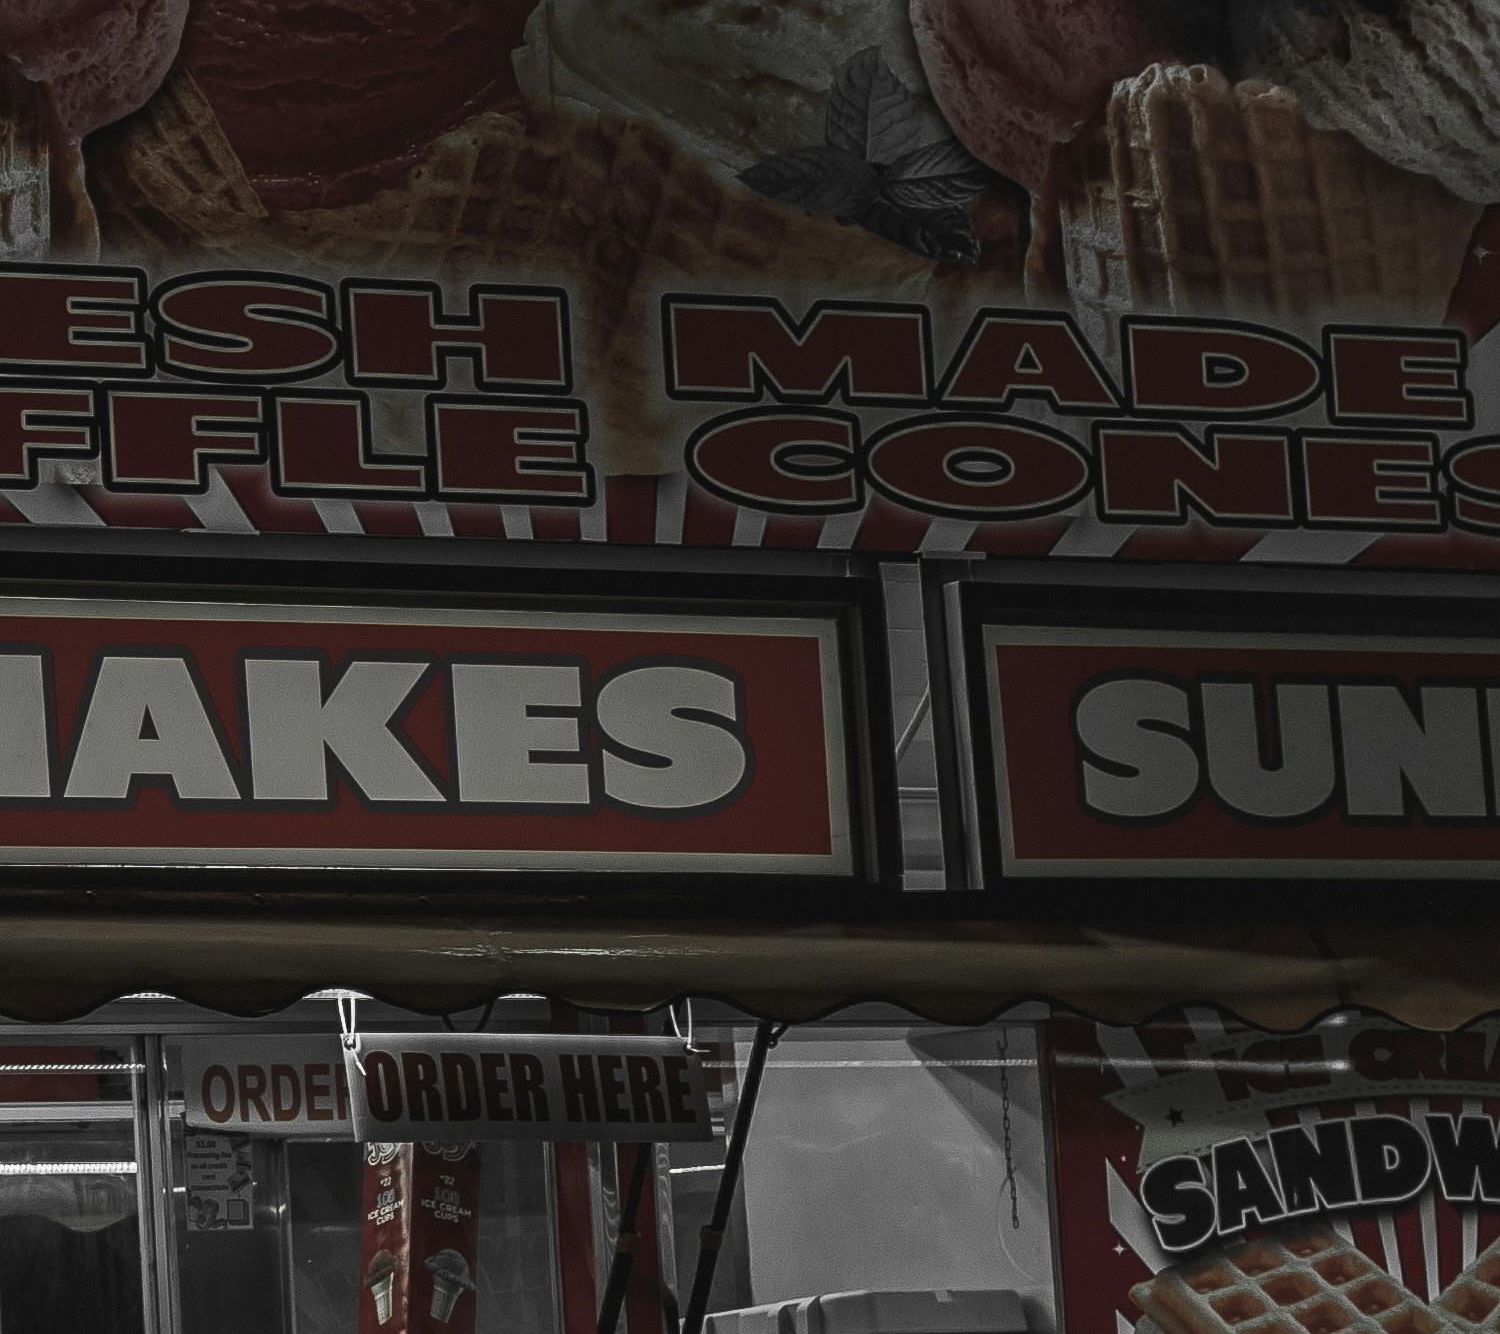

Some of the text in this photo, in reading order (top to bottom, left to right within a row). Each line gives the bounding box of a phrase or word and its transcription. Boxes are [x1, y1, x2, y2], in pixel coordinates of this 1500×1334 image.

[666, 294, 1475, 430] MADE
[364, 1050, 697, 1125] ORDER HERE
[1210, 1033, 1332, 1100] ICE
[421, 1199, 472, 1218] ICE CREAM
[434, 1210, 459, 1223] CUPS
